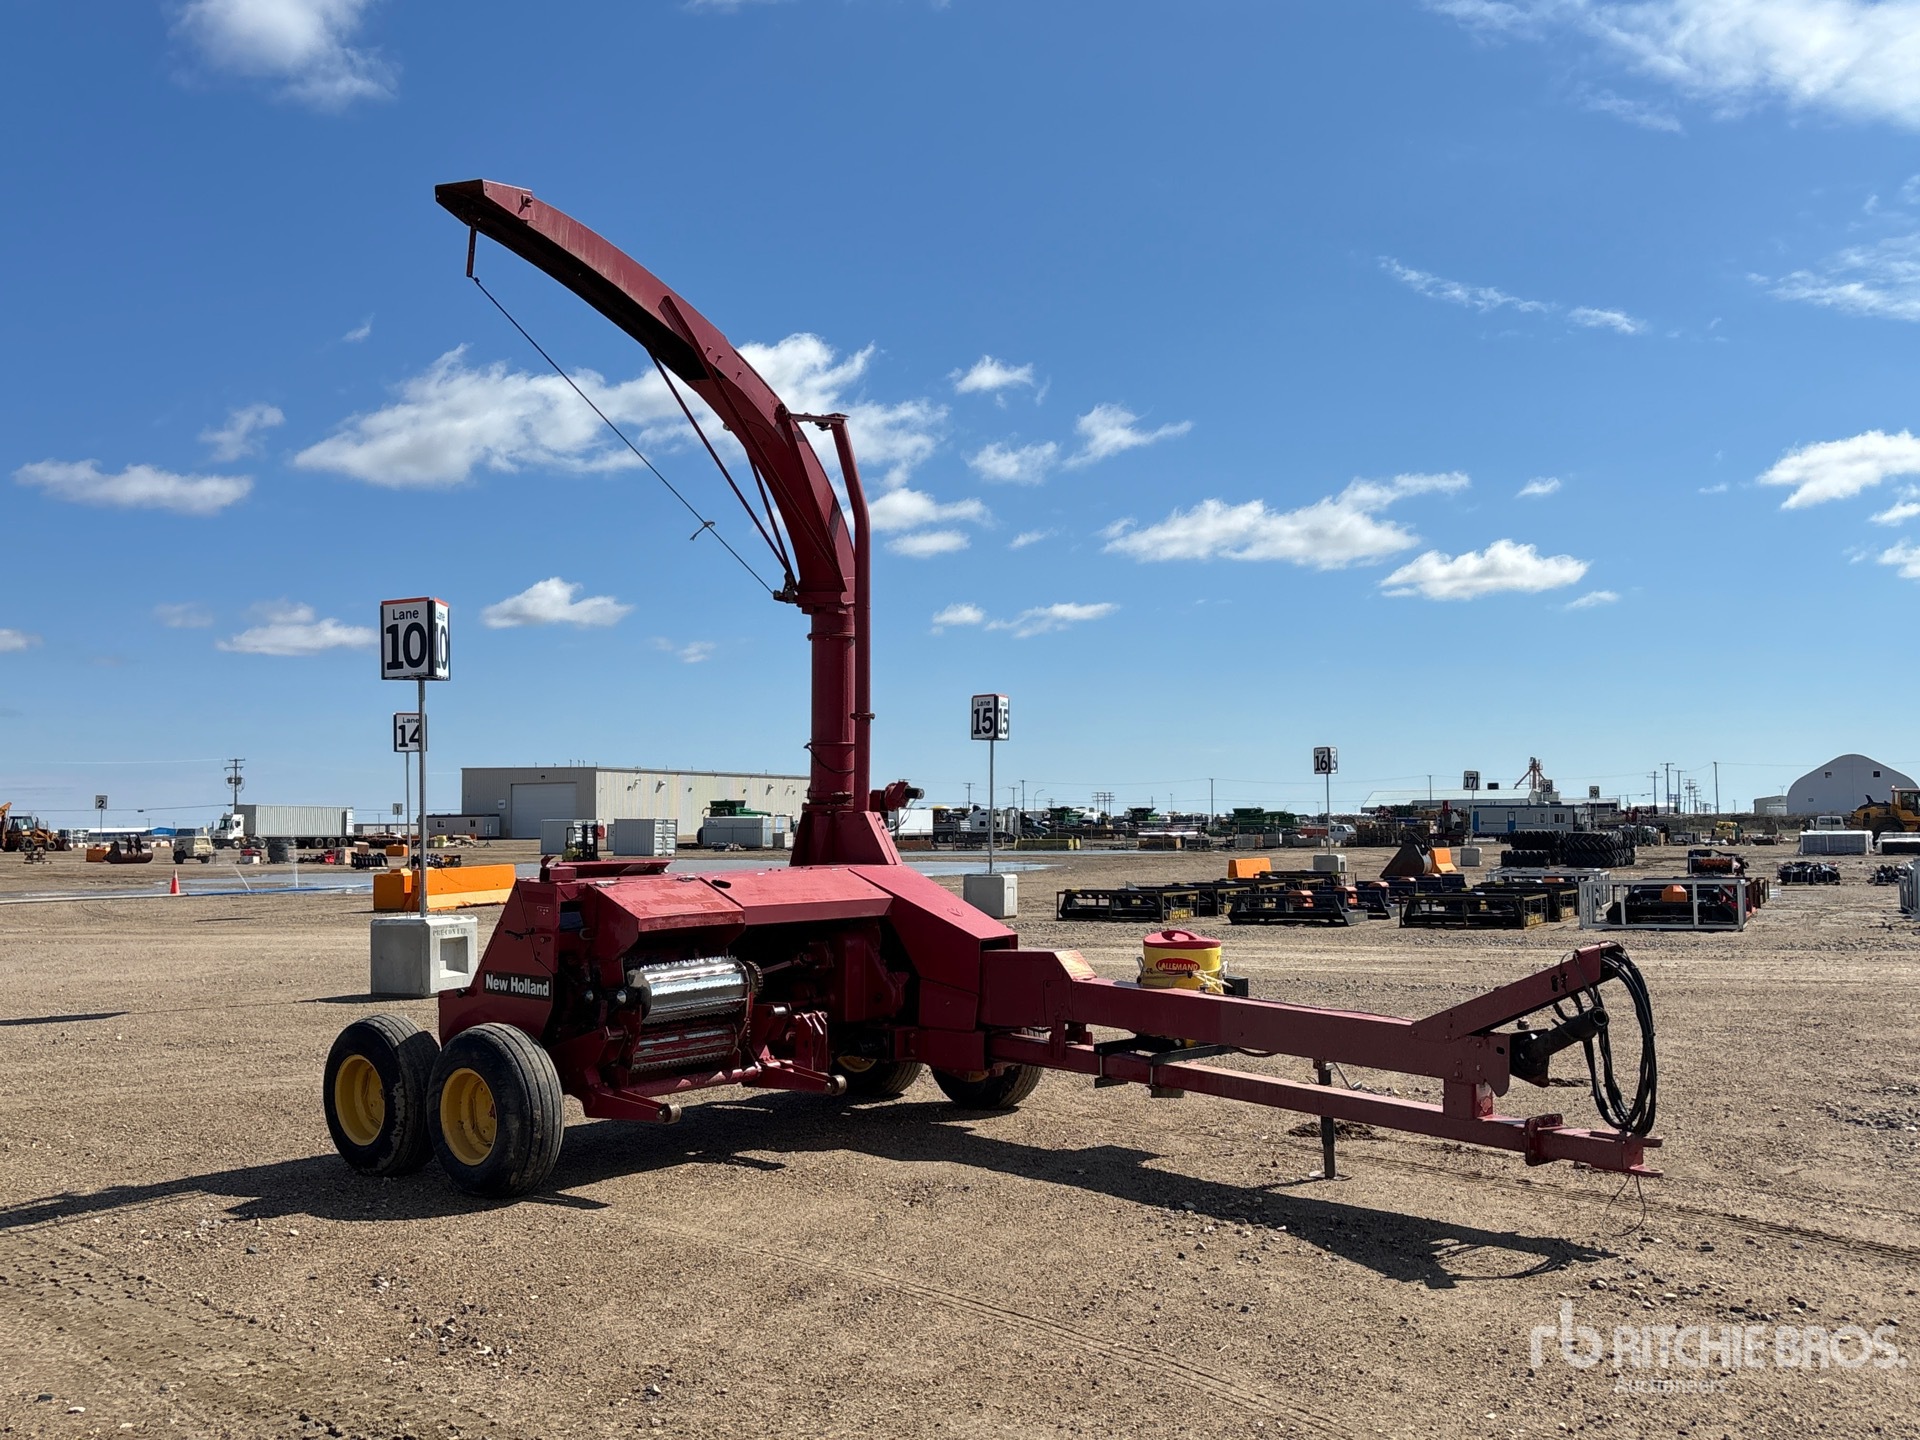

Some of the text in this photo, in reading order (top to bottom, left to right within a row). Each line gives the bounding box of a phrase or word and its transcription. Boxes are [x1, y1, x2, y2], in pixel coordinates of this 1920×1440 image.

[392, 609, 419, 620] Lane
[386, 622, 427, 670] 10
[435, 622, 448, 670] 10
[974, 707, 993, 734] 15
[998, 708, 1008, 735] 15
[398, 724, 421, 747] 14
[1315, 755, 1328, 771] 16
[1465, 776, 1476, 788] 17
[1542, 783, 1550, 793] 18
[98, 799, 105, 809] 2
[1158, 962, 1199, 971] LALLEMAND
[485, 973, 550, 997] New Holland
